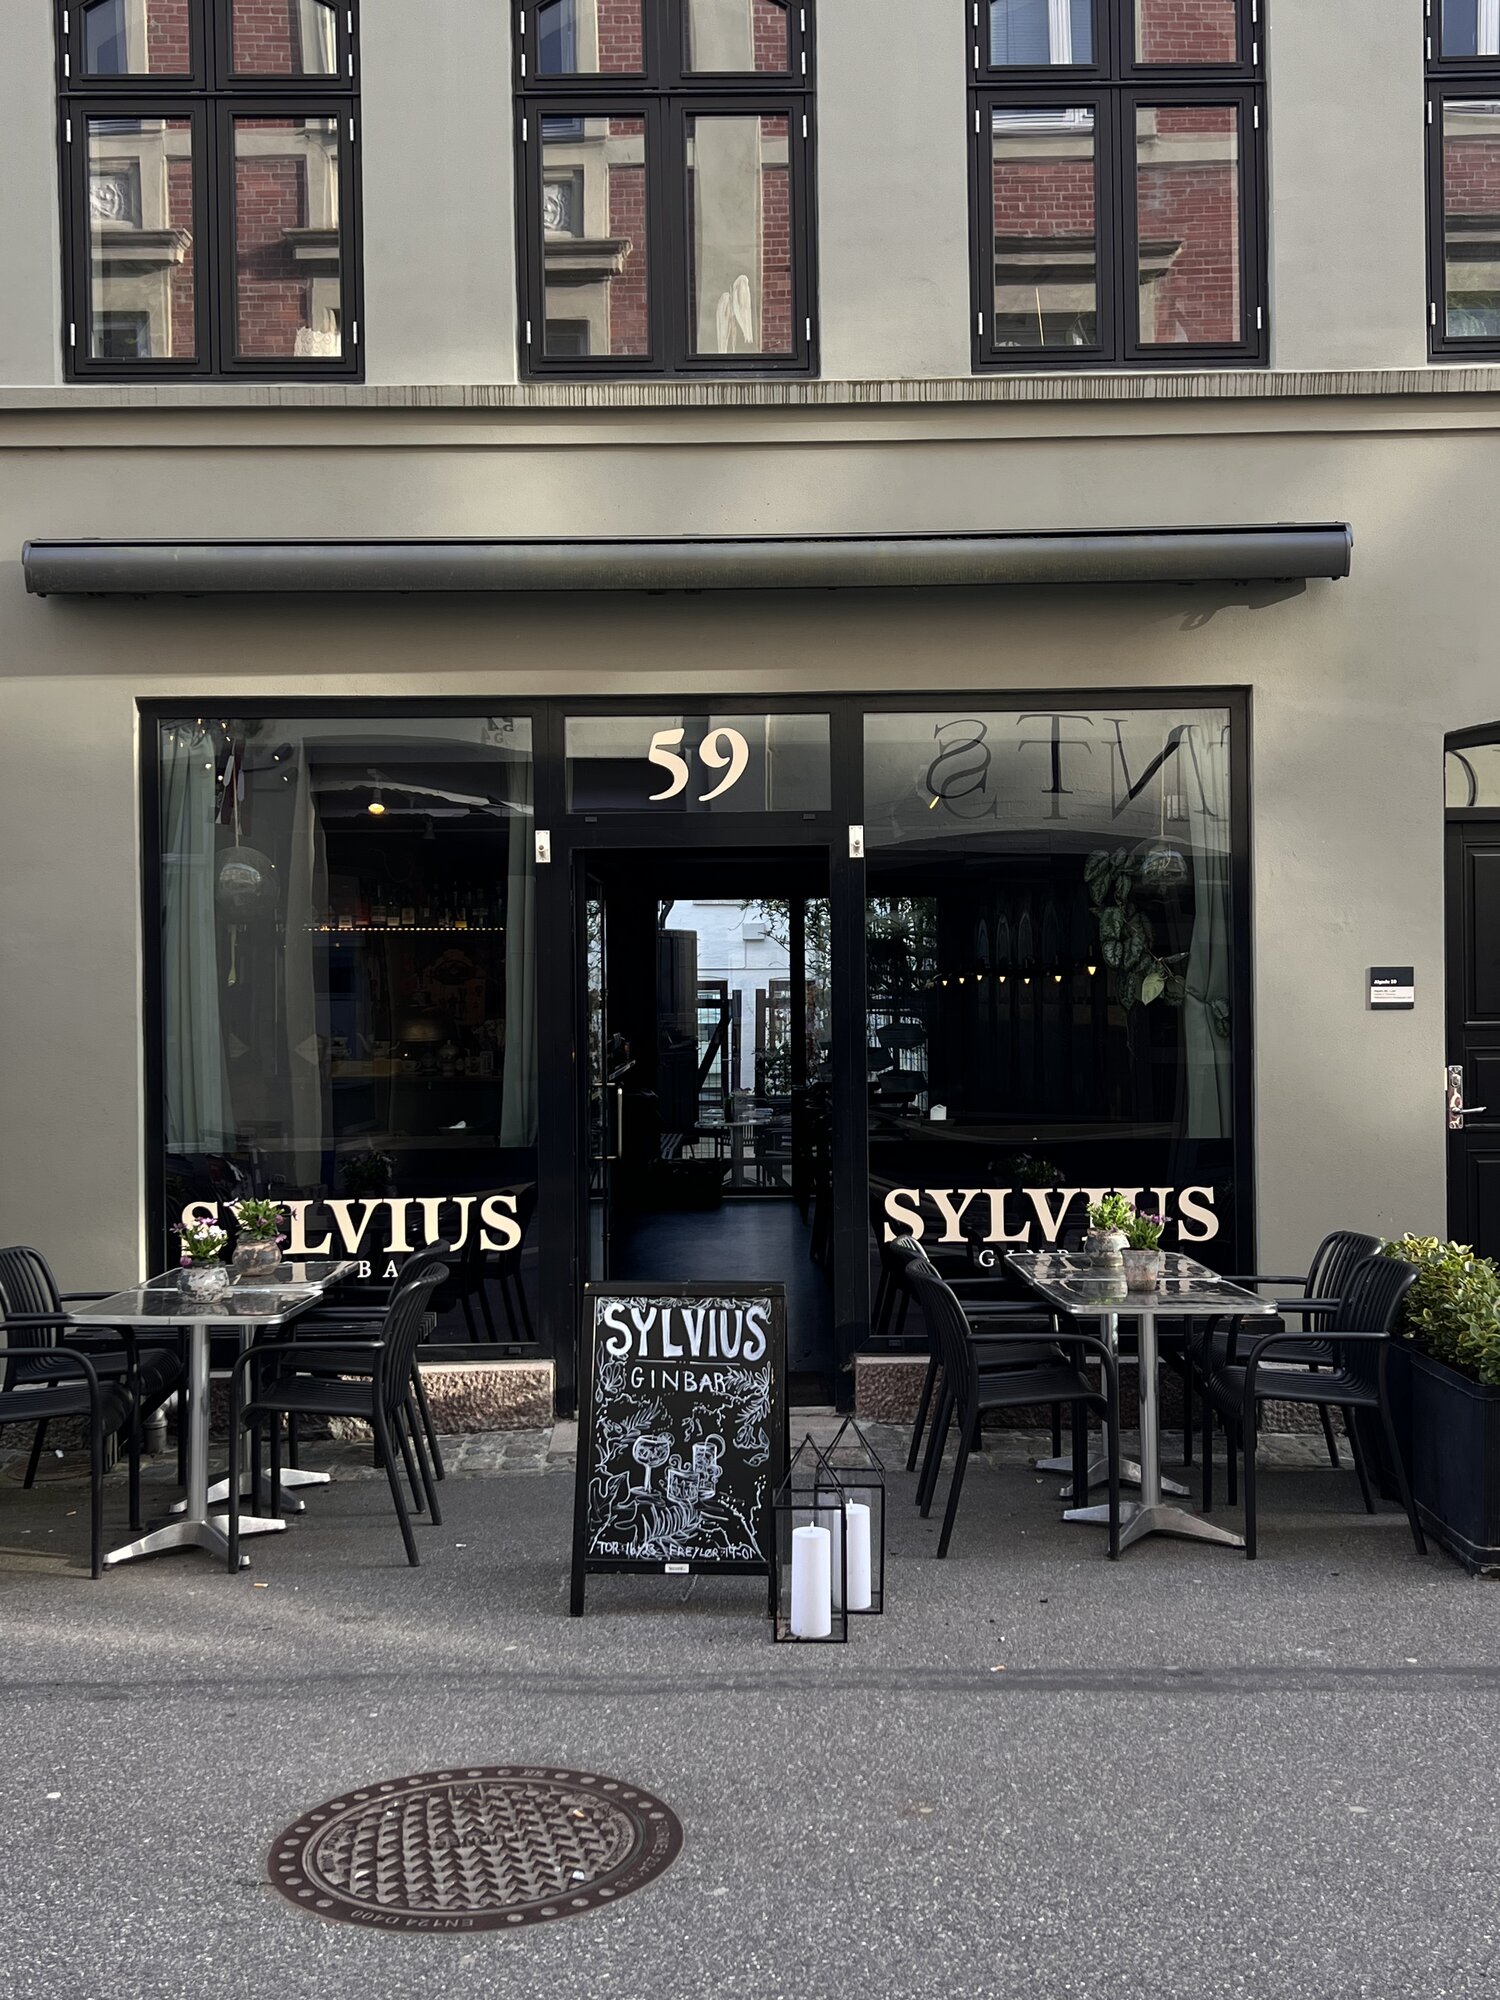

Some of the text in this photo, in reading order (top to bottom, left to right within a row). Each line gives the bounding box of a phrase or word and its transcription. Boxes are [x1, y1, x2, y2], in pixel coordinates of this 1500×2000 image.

[648, 728, 749, 802] 59
[604, 1303, 767, 1361] SYLVIUS
[349, 1909, 400, 1926] D400
